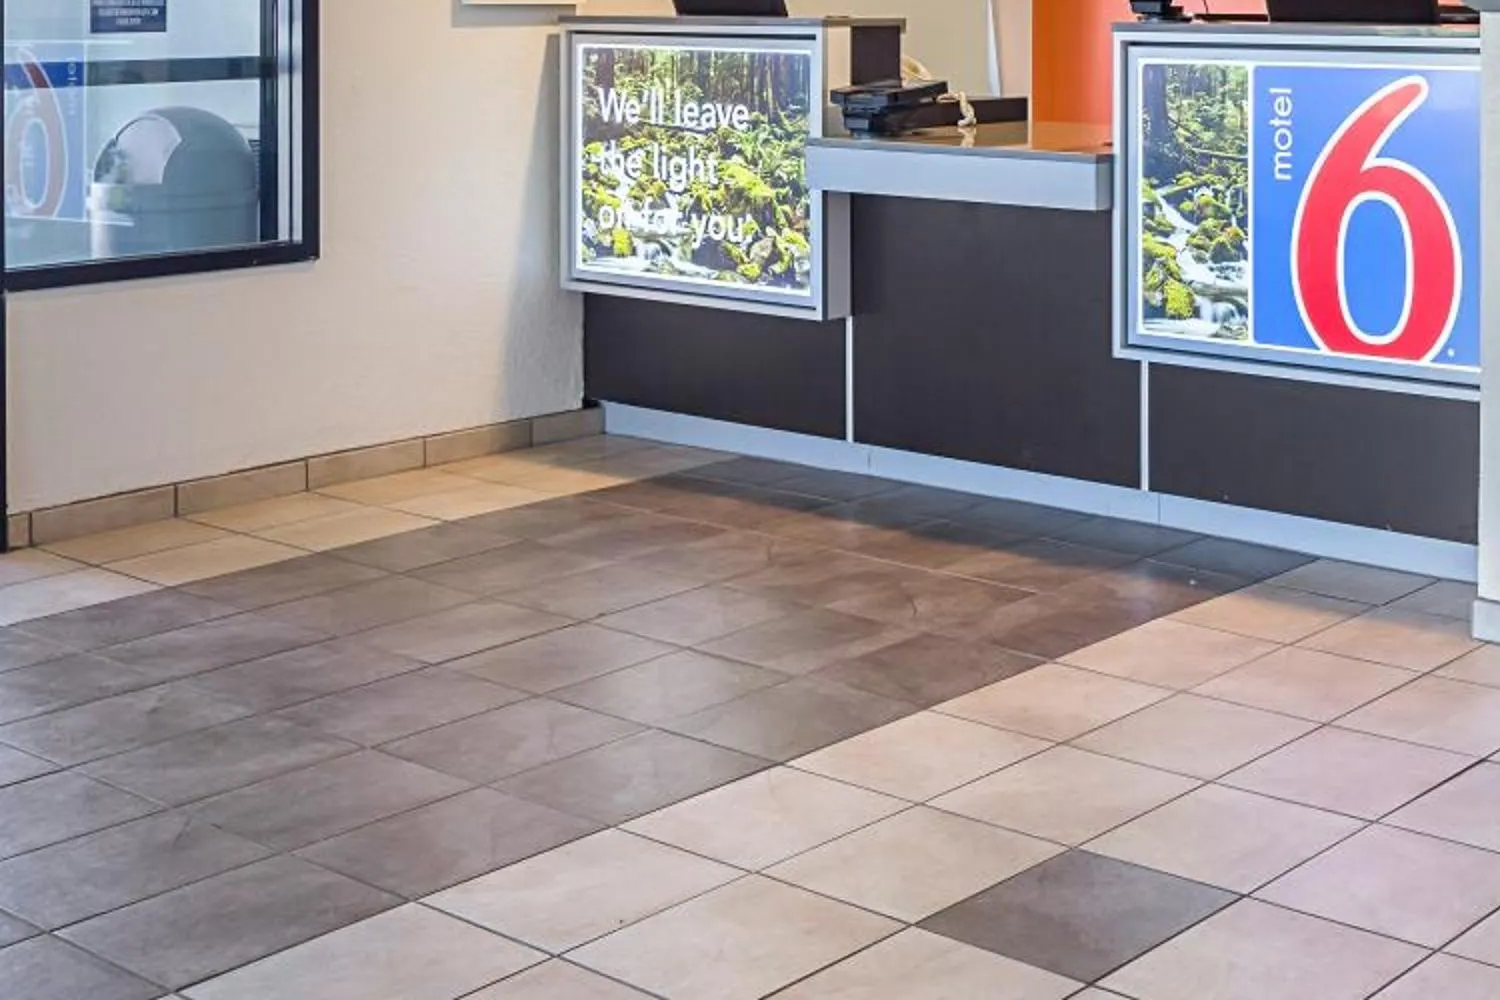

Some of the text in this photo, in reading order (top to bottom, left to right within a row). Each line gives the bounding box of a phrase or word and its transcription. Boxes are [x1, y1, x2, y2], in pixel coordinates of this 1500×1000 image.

[599, 87, 749, 131] We'll leave
[1269, 87, 1293, 181] motel
[600, 140, 718, 193] the light
[1290, 75, 1463, 363] 6
